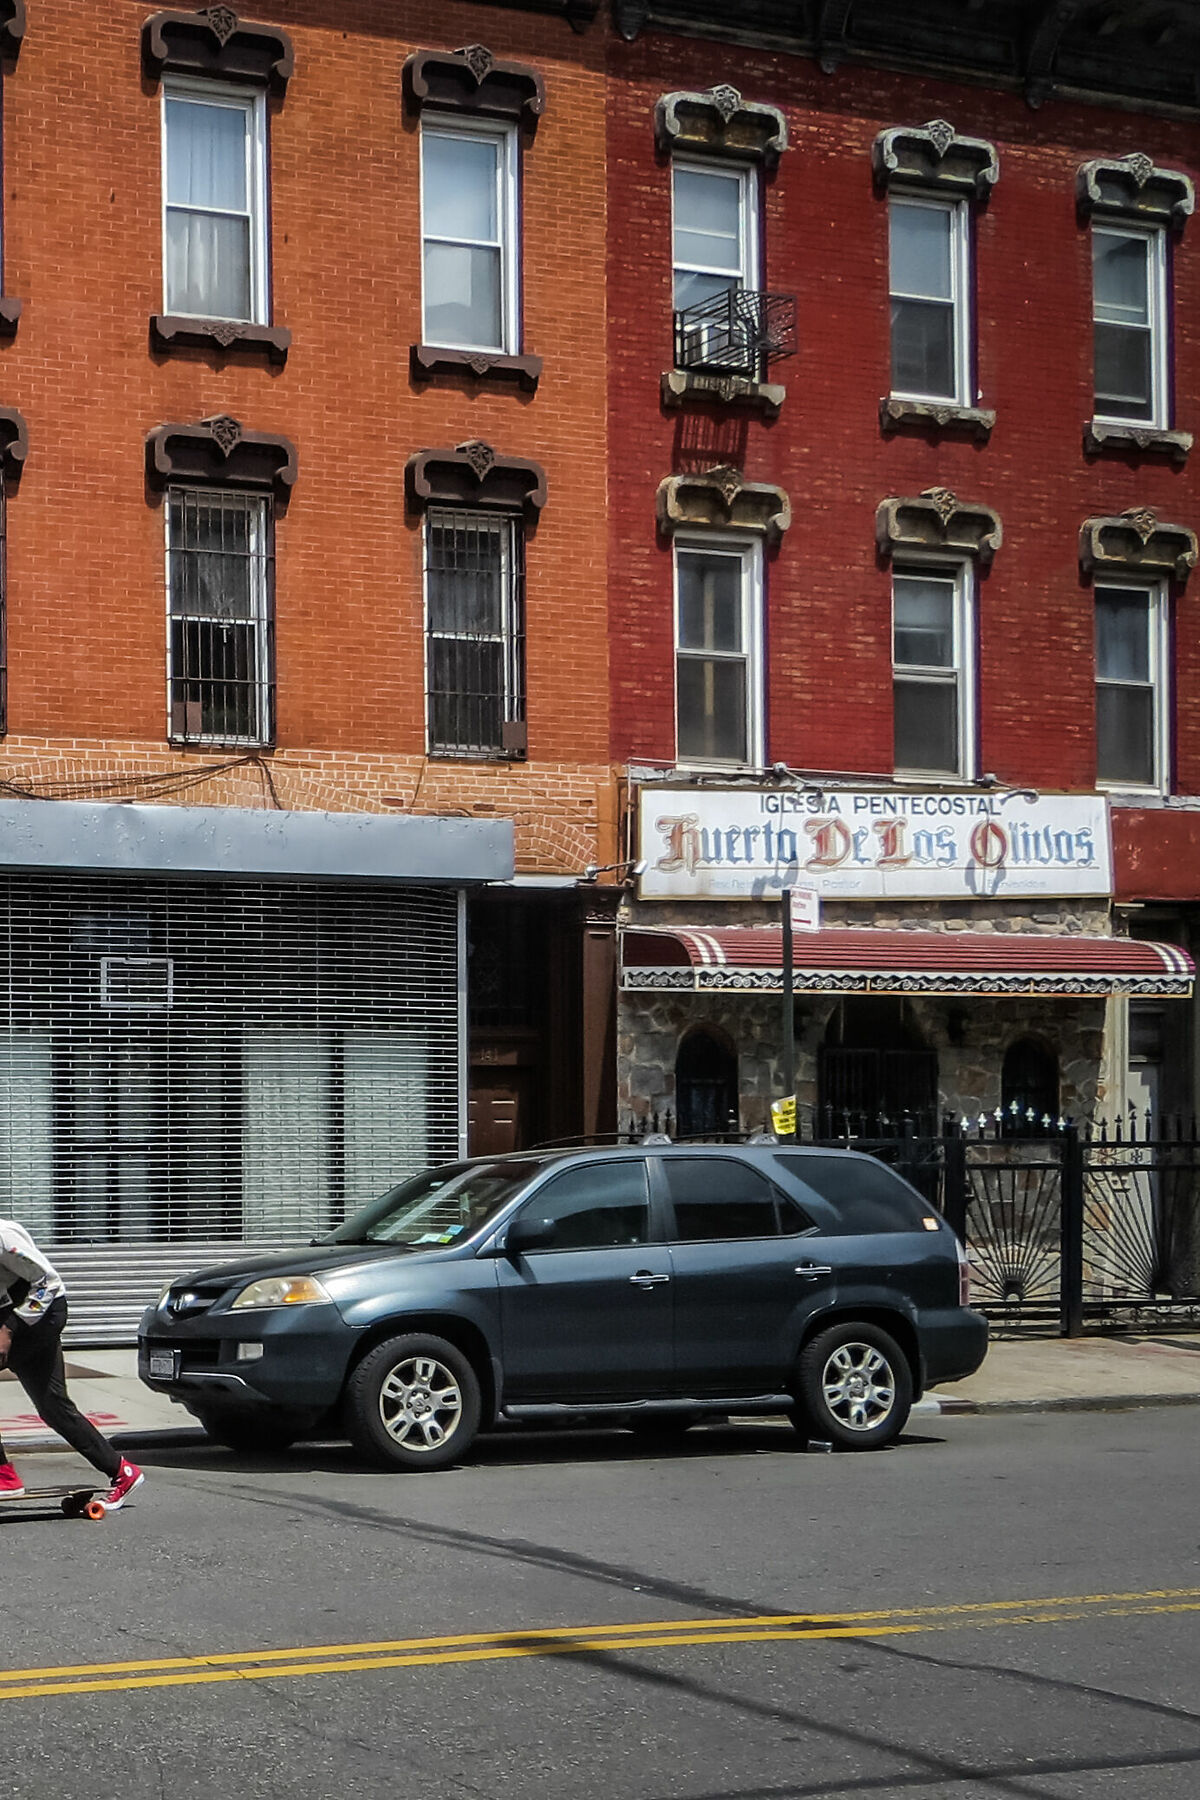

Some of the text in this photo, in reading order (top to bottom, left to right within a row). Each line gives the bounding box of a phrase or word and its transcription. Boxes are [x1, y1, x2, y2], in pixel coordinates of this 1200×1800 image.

[760, 794, 1001, 816] IGLESIA PENTECOSTAL
[655, 812, 1096, 877] Huerto De Los Olivos
